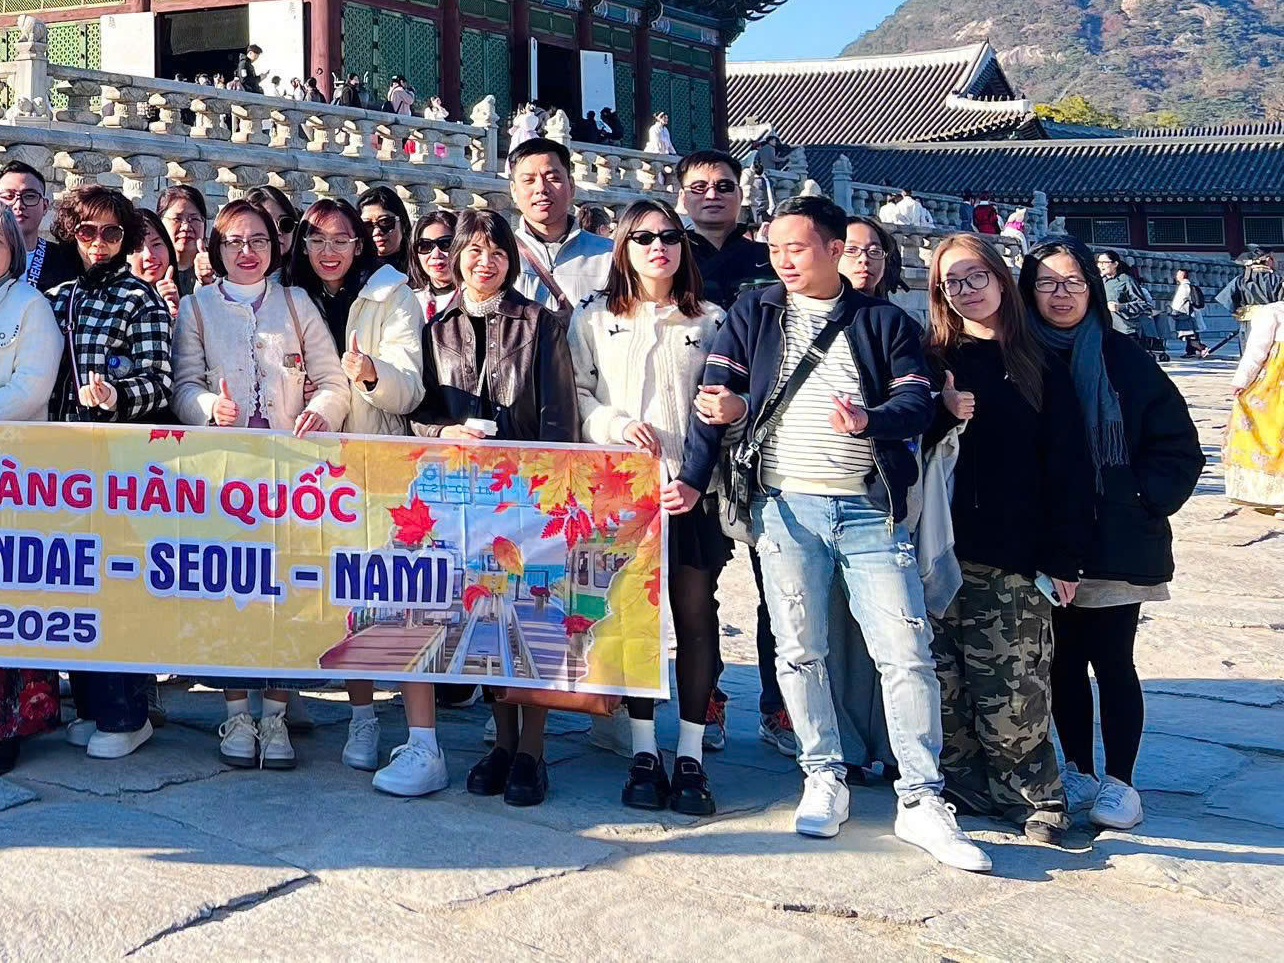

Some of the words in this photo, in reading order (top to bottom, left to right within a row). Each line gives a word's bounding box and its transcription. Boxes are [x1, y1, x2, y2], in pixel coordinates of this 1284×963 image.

[109, 465, 205, 513] HÀN
[220, 465, 357, 525] QUỐC
[150, 542, 281, 596] SEOUL
[335, 552, 448, 603] NAMI
